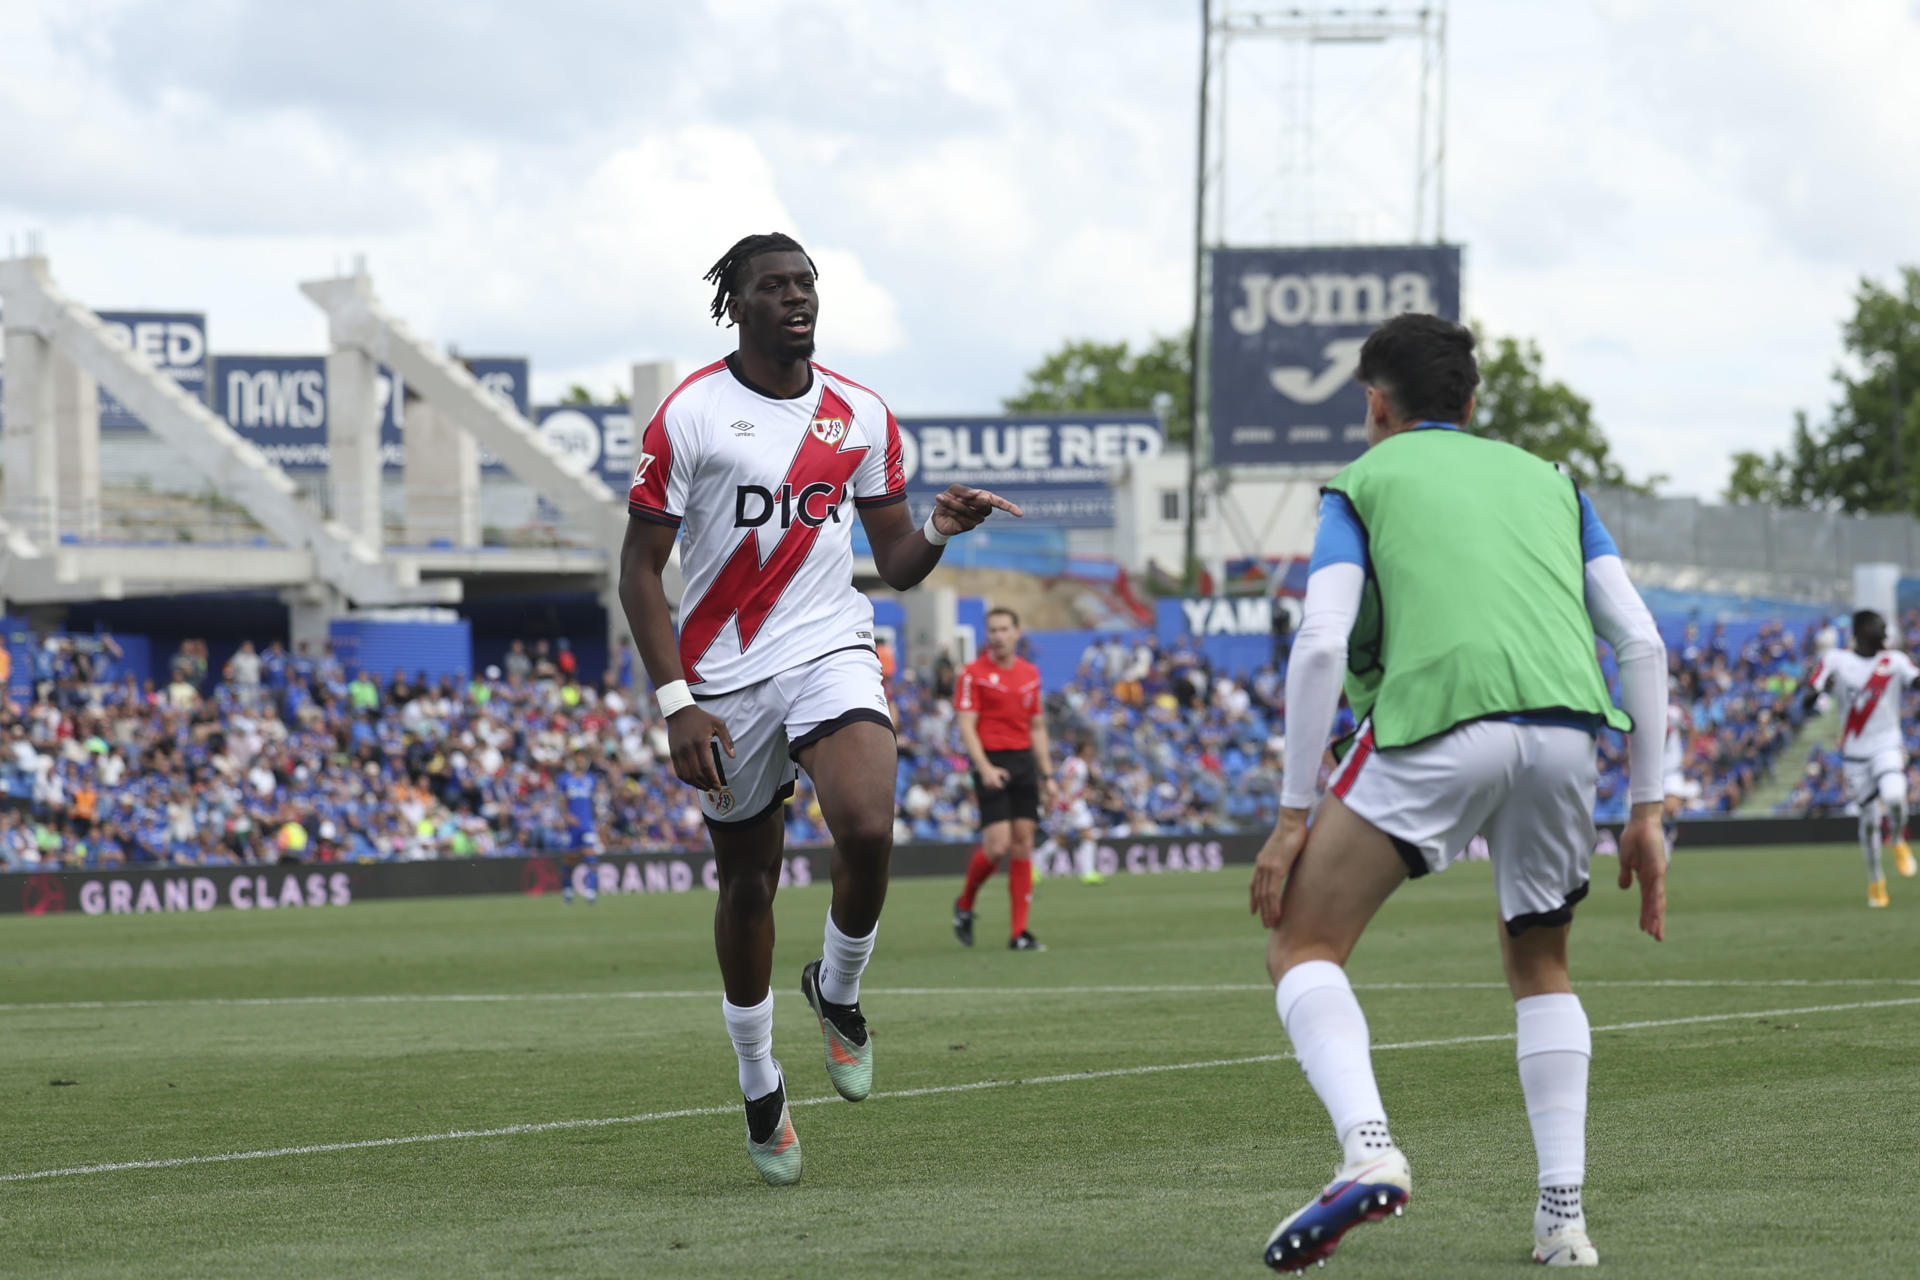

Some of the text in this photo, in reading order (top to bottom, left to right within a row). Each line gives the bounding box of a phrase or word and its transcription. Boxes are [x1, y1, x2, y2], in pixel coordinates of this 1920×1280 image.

[919, 423, 1164, 470] BLUE RED
[1125, 840, 1224, 875] CLASS
[79, 871, 351, 916] GRAND CLASS
